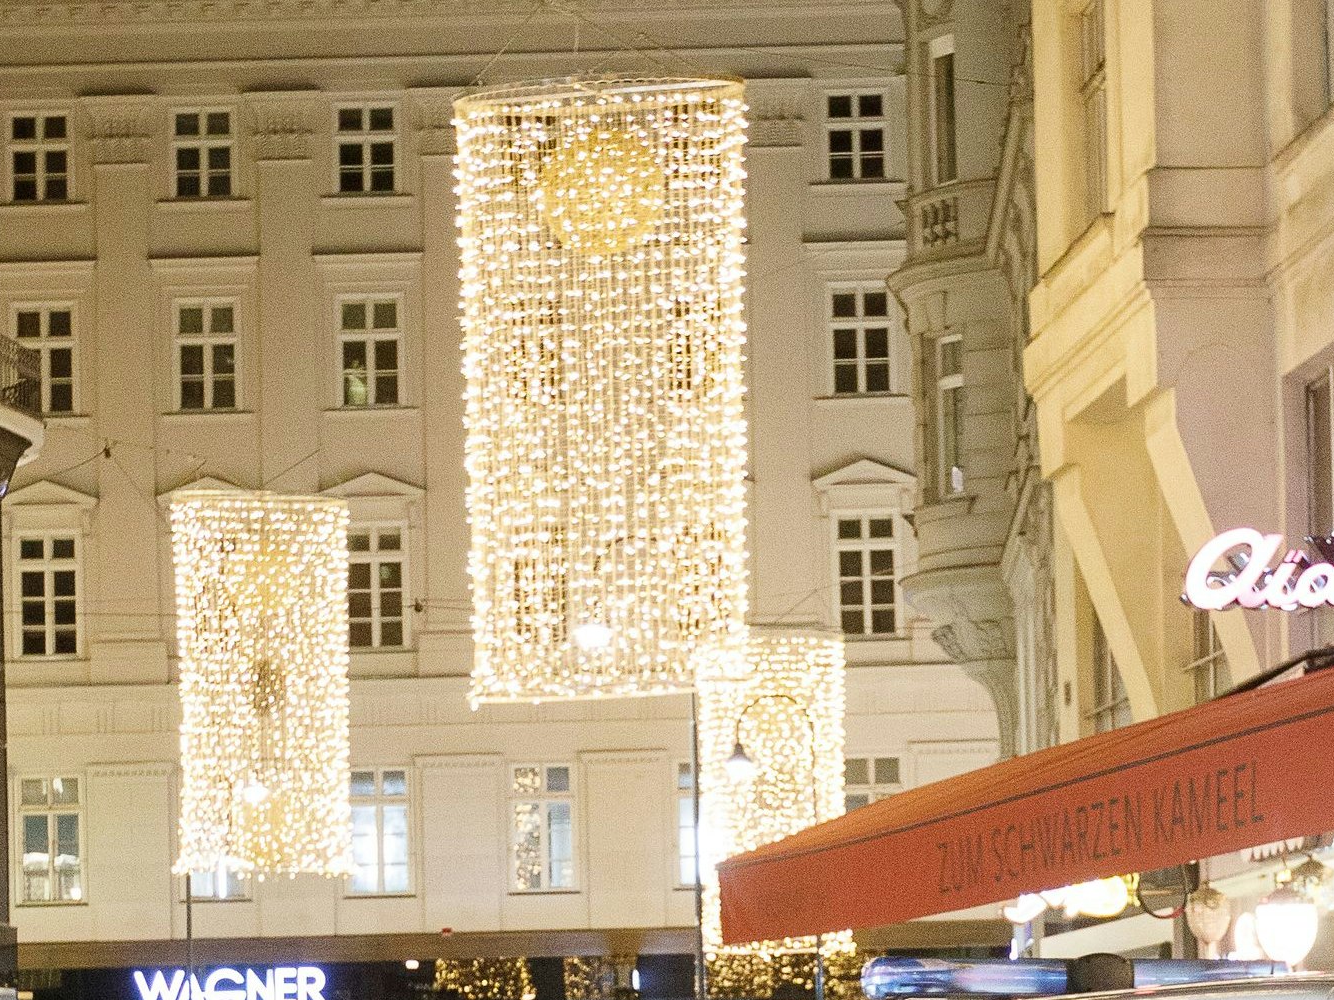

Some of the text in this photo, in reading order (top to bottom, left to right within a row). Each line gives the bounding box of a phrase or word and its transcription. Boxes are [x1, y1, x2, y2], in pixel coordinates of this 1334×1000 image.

[937, 760, 1265, 896] ZUM SCHWARZEN KAMEEL
